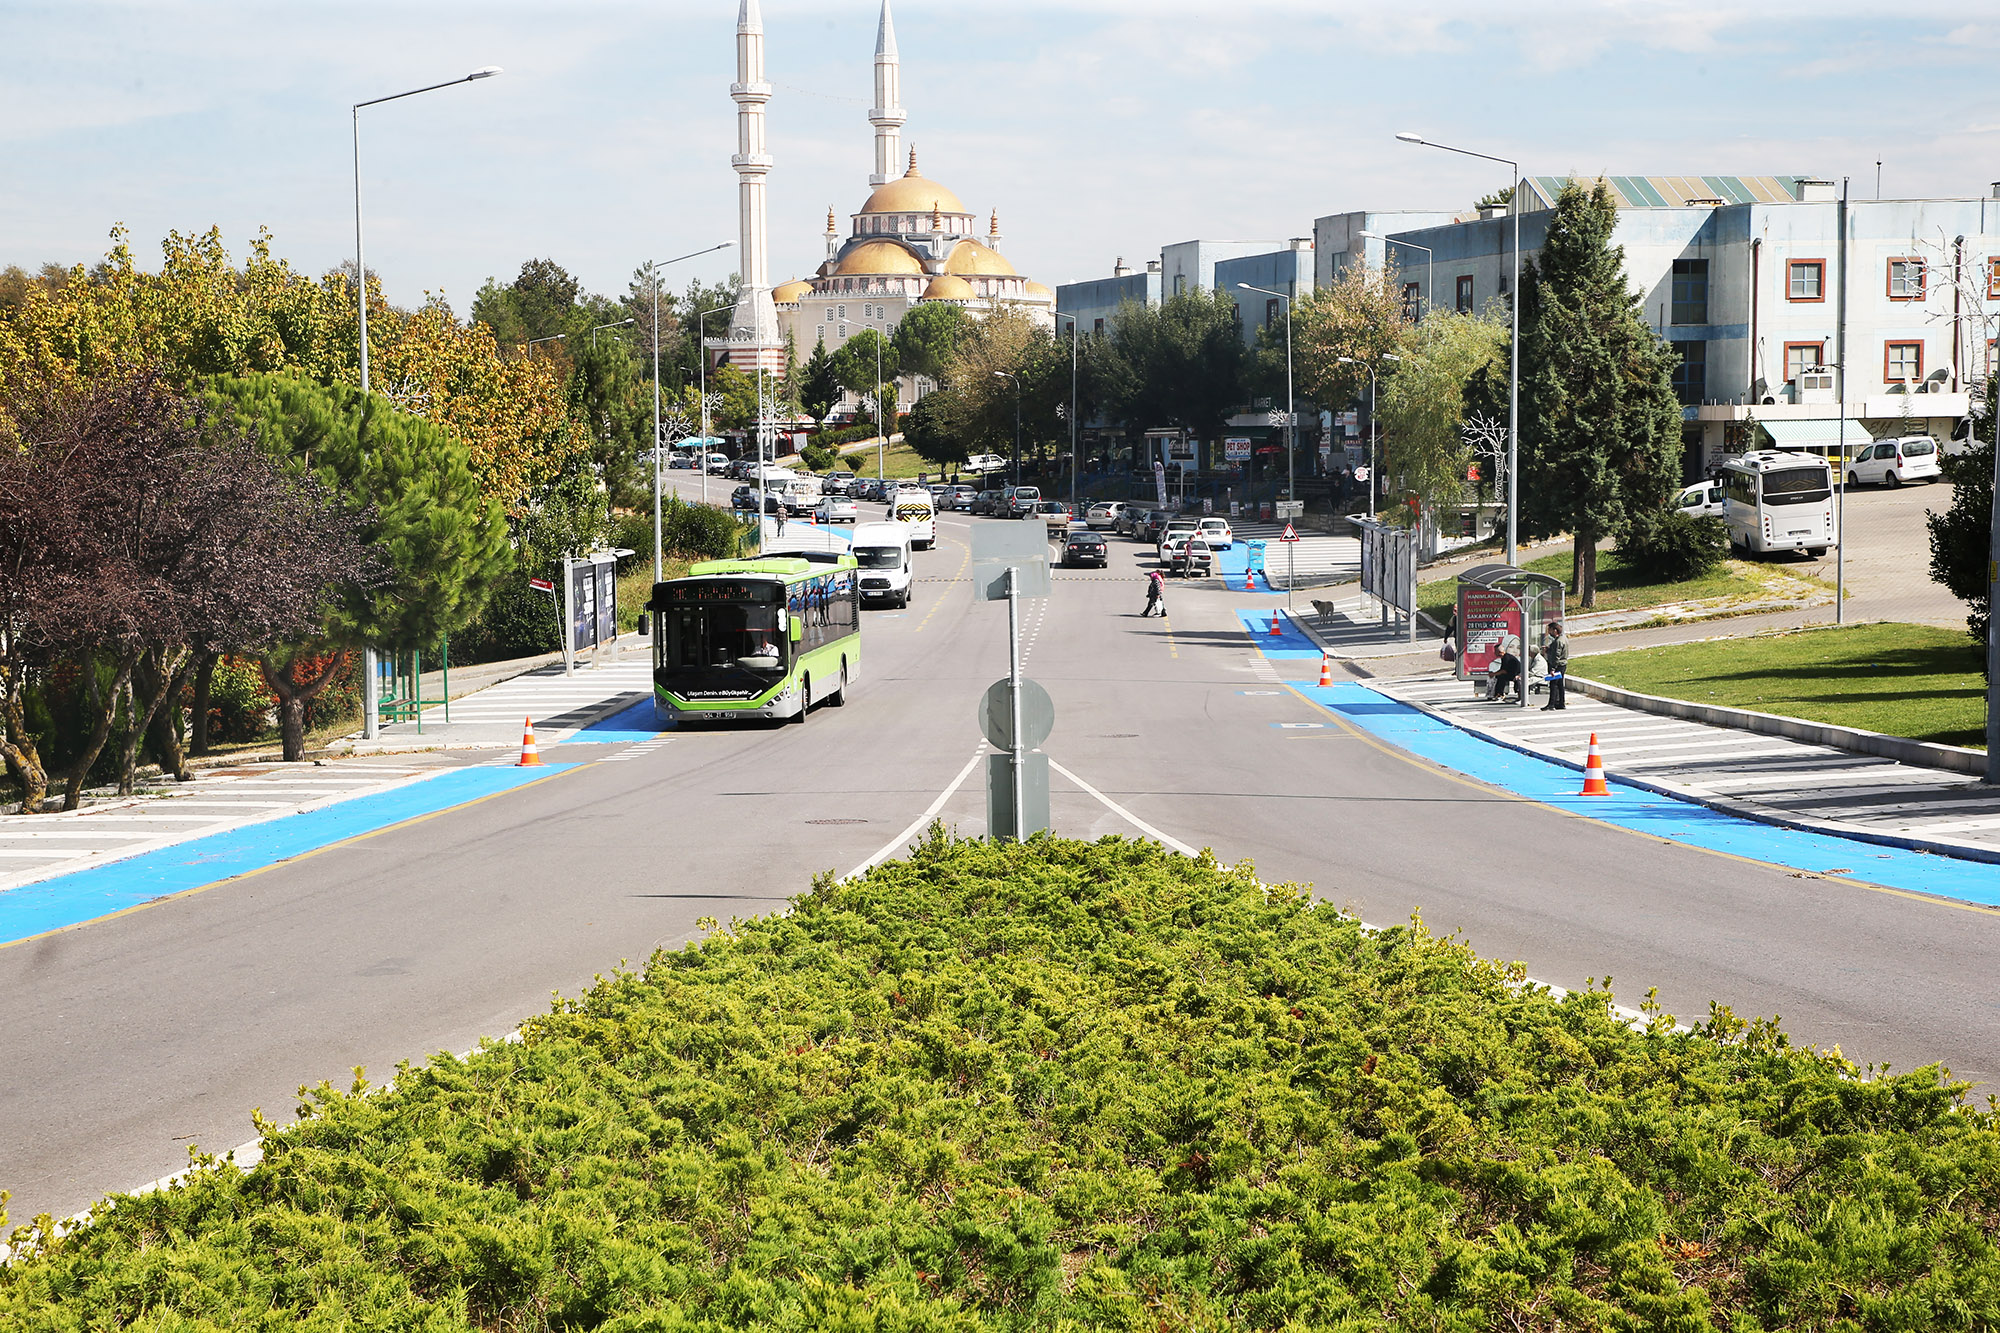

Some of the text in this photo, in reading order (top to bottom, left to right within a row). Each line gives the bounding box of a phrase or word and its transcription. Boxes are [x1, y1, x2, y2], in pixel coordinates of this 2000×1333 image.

[1868, 421, 1892, 436] Elif
[1226, 442, 1250, 451] PET SHOP
